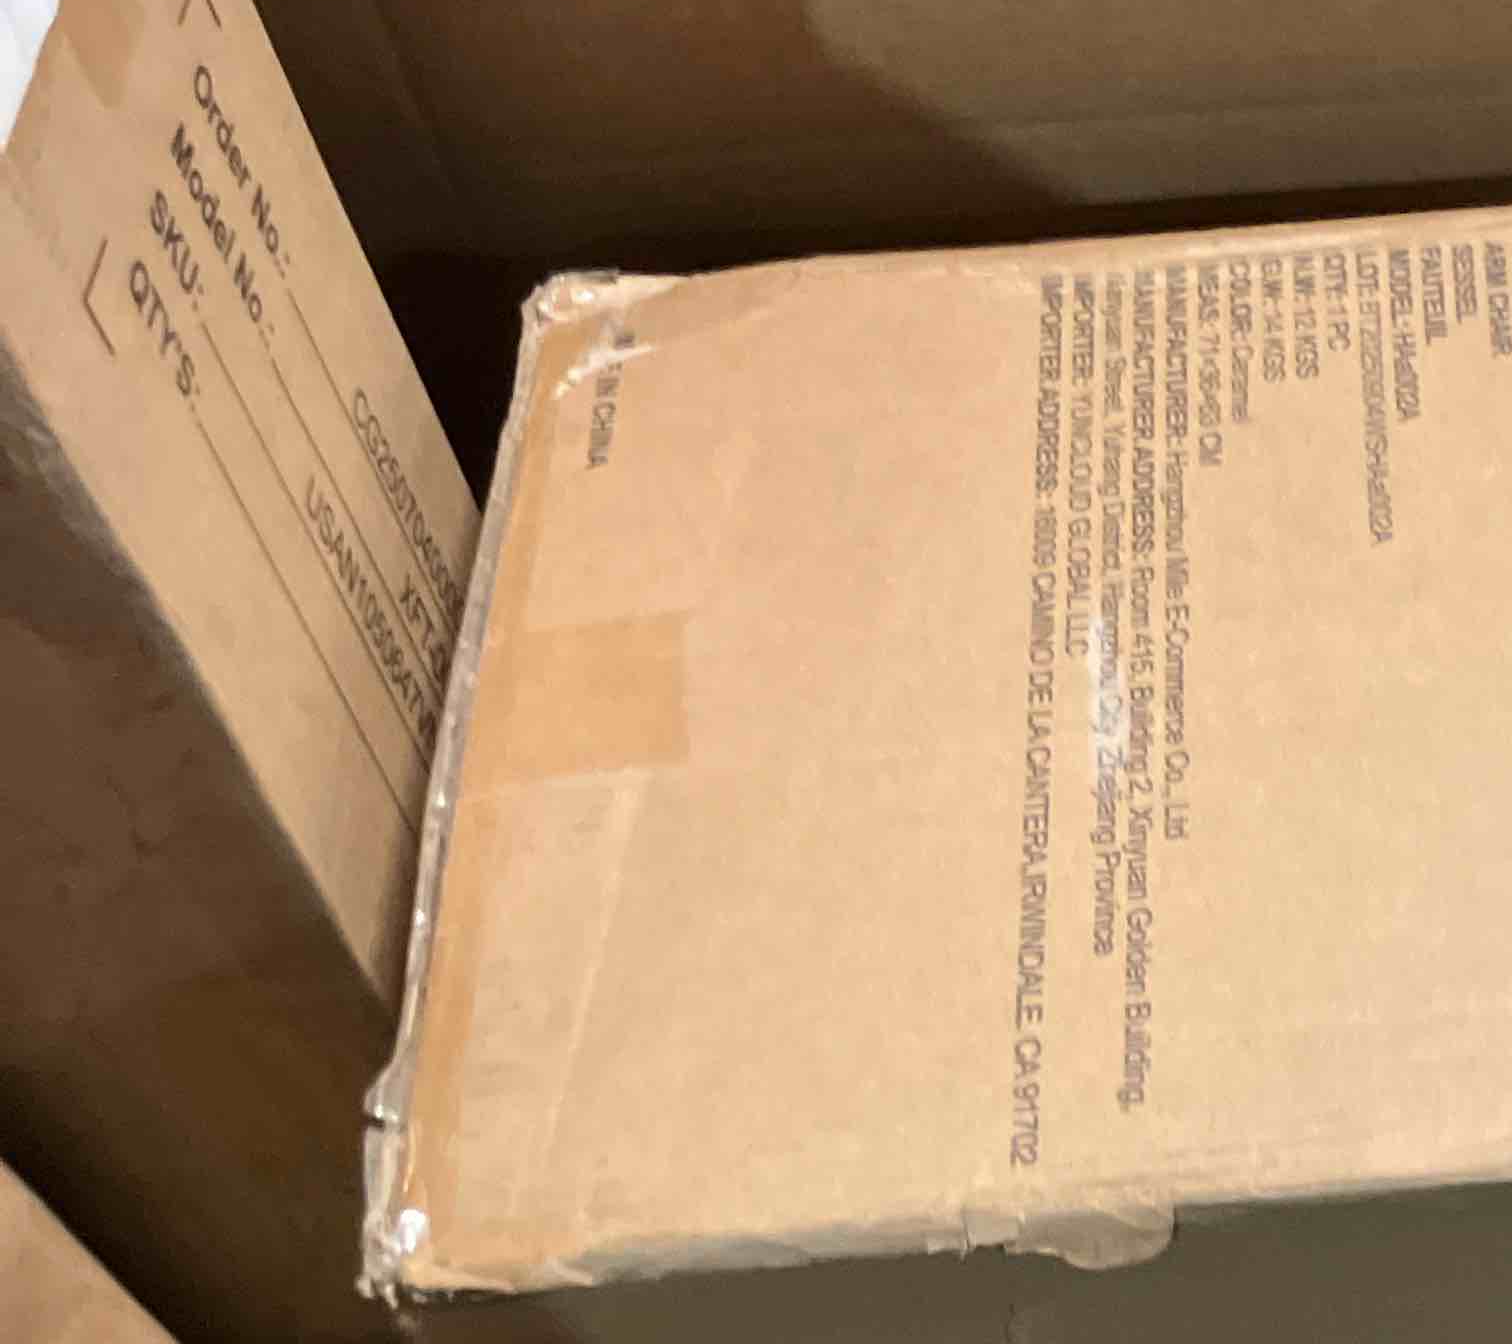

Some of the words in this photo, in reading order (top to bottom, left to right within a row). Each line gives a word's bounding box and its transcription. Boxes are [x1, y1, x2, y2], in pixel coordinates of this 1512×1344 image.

[190, 65, 251, 188] Order
[168, 122, 237, 261] Model
[1228, 260, 1253, 339] COLOR:
[1324, 253, 1347, 299] QTY:
[1355, 251, 1380, 297] LOT:
[1388, 248, 1413, 329] MODEL:
[1421, 246, 1448, 346] FAUTEUIL
[1452, 243, 1478, 323] SESSEL
[1484, 242, 1510, 289] ARM
[1037, 274, 1062, 384] IMPORTER
[1070, 276, 1094, 386] IMPORTER:
[1130, 271, 1154, 441] MANUFACTURER
[1164, 266, 1187, 447] MANUFACTURER:
[1262, 310, 1285, 334] 14
[1263, 338, 1287, 383] KGS
[1294, 307, 1317, 330] 12
[1295, 334, 1319, 380] KGS
[1327, 321, 1351, 353] PC
[1231, 345, 1255, 424] Caramel
[587, 402, 618, 470] CHINA
[1033, 389, 1060, 499] ADDRESS:
[1067, 392, 1092, 514] YUNCLOUD
[1096, 423, 1123, 497] Yuhang
[1199, 431, 1223, 467] CM
[1130, 446, 1154, 562] ADDRESS:
[1159, 450, 1187, 551] Hangzhou
[1065, 518, 1090, 606] GLOBAL
[1130, 567, 1154, 628] Room
[1028, 572, 1054, 667] CAMINO
[1063, 612, 1088, 658] LLC
[1096, 581, 1122, 685] Hangzhou
[1029, 672, 1054, 706] DE
[1164, 605, 1189, 745] E-Commerce
[1027, 710, 1053, 742] LA
[1127, 687, 1154, 774] Building
[1090, 745, 1122, 845] Zhejiang
[1122, 807, 1153, 902] Xinyuan
[1093, 851, 1121, 956] Province
[1124, 908, 1152, 996] Golden
[1014, 1037, 1041, 1080] CA
[1009, 1083, 1041, 1168] 91702
